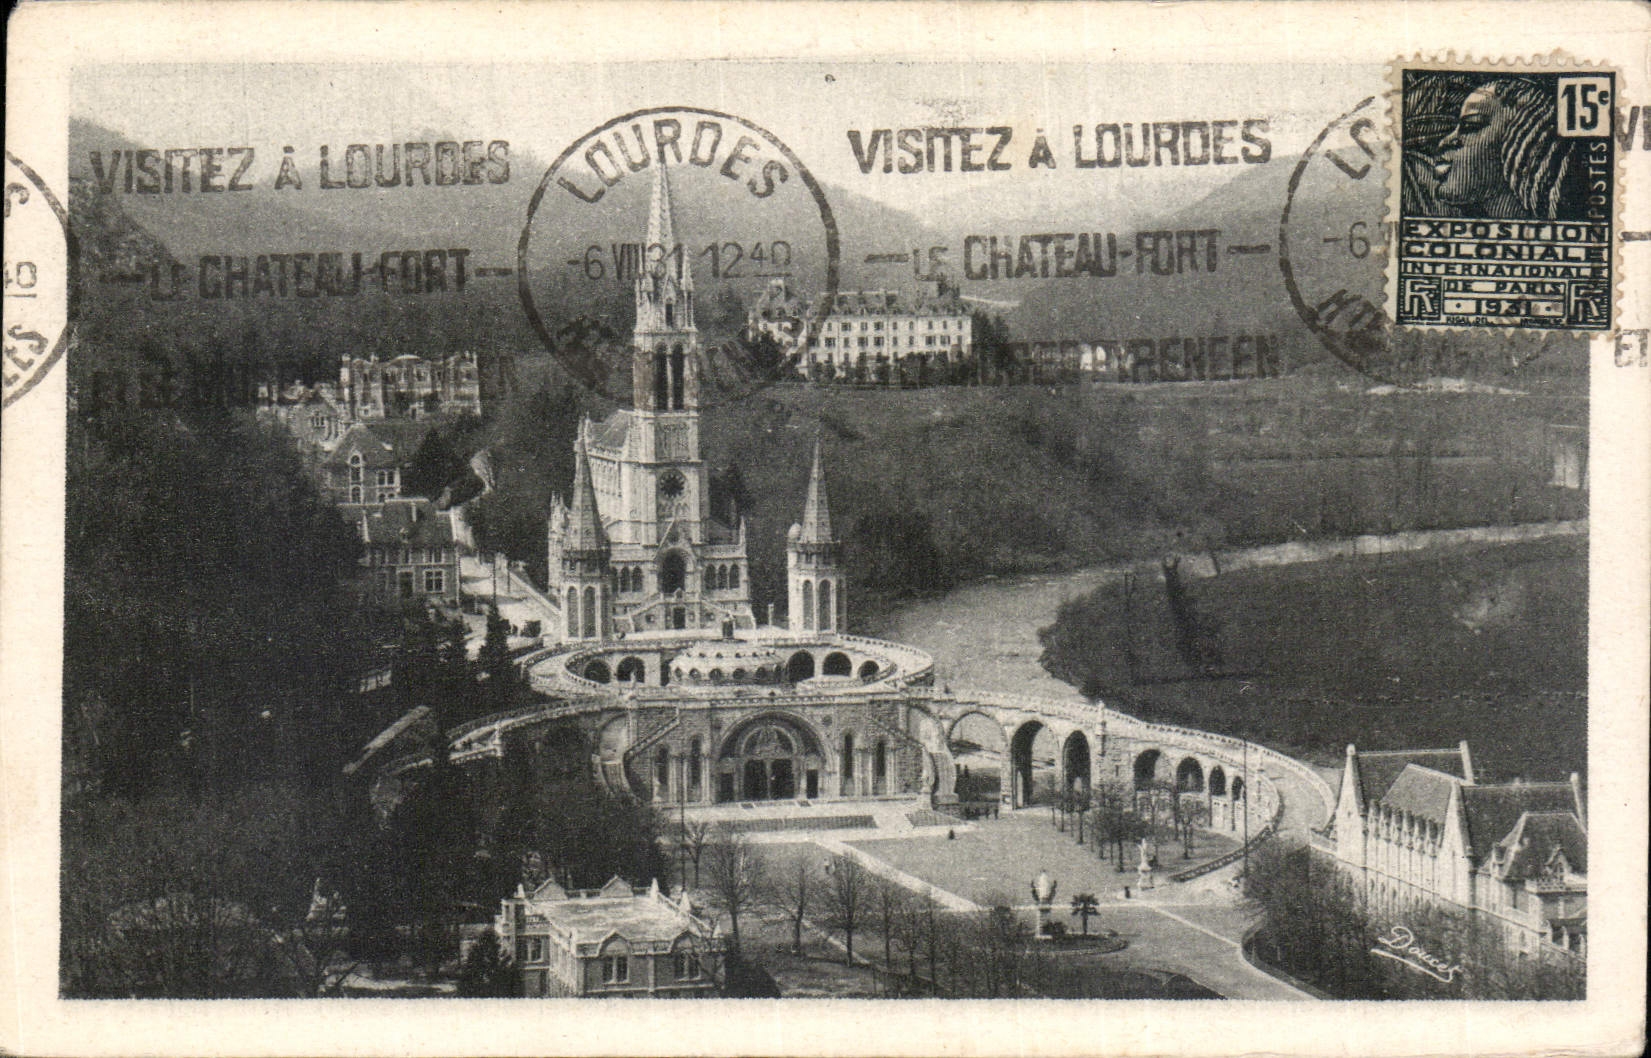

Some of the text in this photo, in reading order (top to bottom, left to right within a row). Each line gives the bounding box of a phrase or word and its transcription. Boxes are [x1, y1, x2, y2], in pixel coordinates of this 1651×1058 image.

[90, 147, 255, 195] VISITEZ
[320, 140, 510, 189] LOURDES
[557, 118, 789, 203] LOURDES
[848, 125, 1013, 174] VISITEZ
[1073, 119, 1272, 168] LOURDES
[1588, 142, 1607, 219] POSTES
[1403, 222, 1608, 242] EXPOSITION
[1403, 243, 1606, 261] COLONIALE
[701, 242, 745, 278] 12
[912, 229, 1221, 281] LE CHATEAU-FORT
[1401, 262, 1608, 278] INTERNATIONALE
[1446, 280, 1562, 295] DE PARIS
